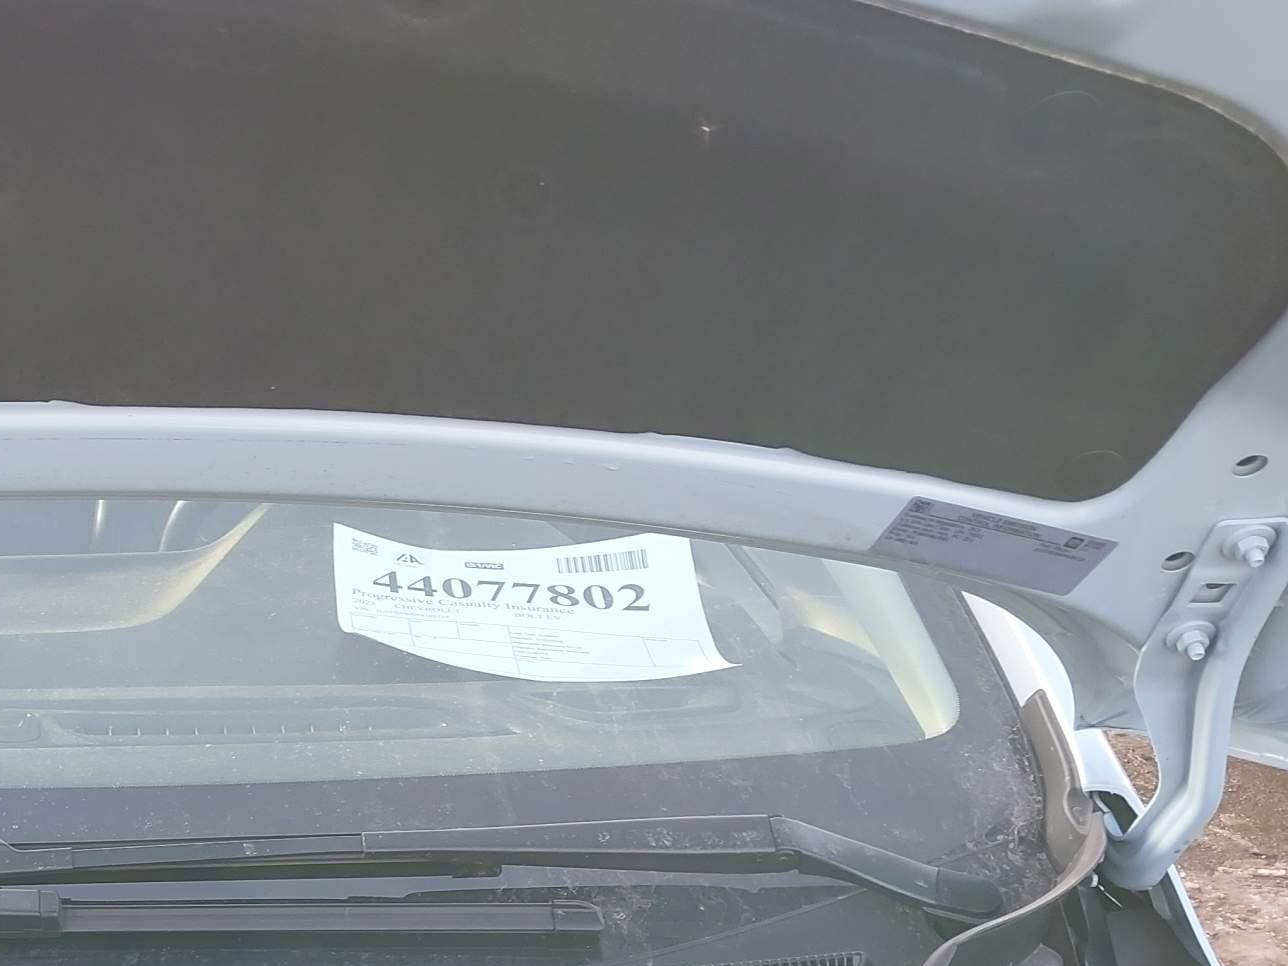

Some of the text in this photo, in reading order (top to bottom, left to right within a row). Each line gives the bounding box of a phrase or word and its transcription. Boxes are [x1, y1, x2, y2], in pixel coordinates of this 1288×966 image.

[352, 587, 576, 615] Progressive Casualty Insurance
[373, 571, 650, 612] 44077802
